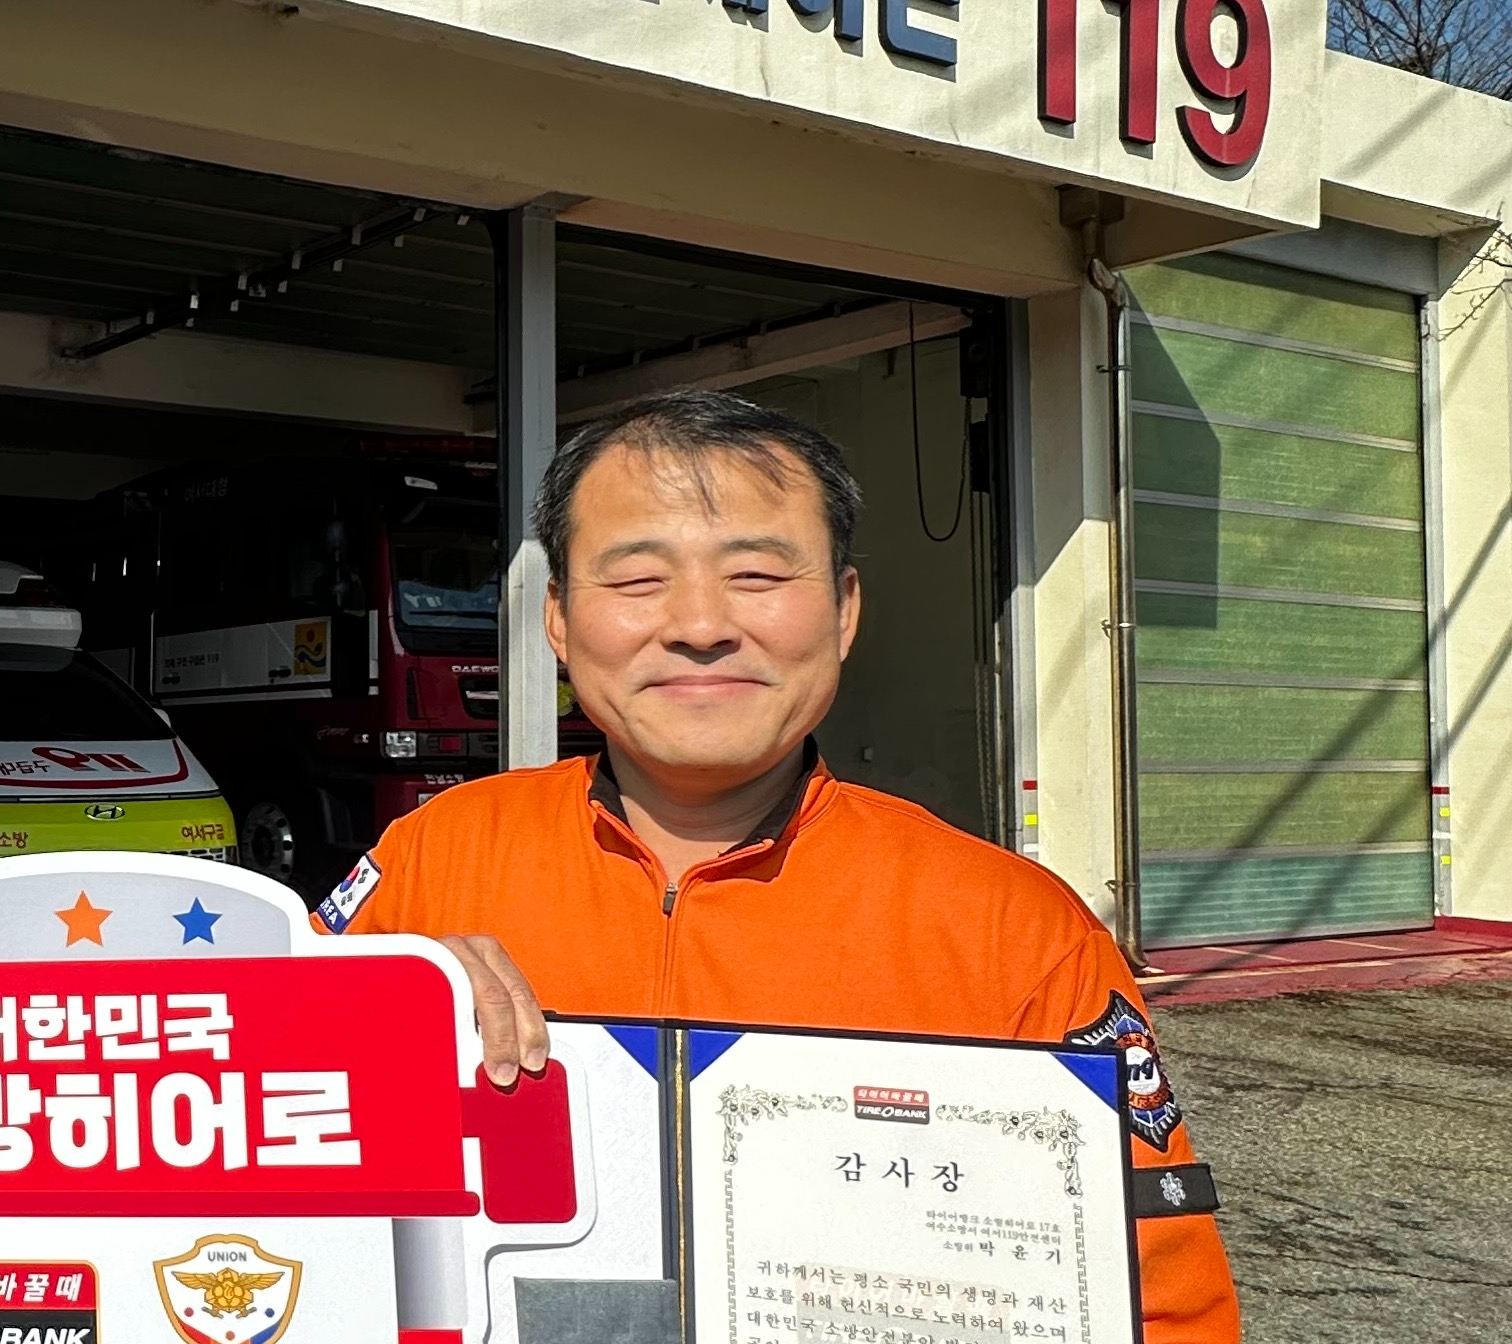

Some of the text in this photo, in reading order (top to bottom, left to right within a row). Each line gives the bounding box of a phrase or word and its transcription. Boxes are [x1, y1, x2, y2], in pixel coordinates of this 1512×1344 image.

[206, 1249, 249, 1263] UNION
[757, 1260, 1067, 1314] 귀하께서는 평소 국민의 생명과 재산
[746, 1285, 1067, 1343] 보호를 위해 헌신적으로 노력하여 왔으며
[747, 1310, 817, 1334] 대한민국
